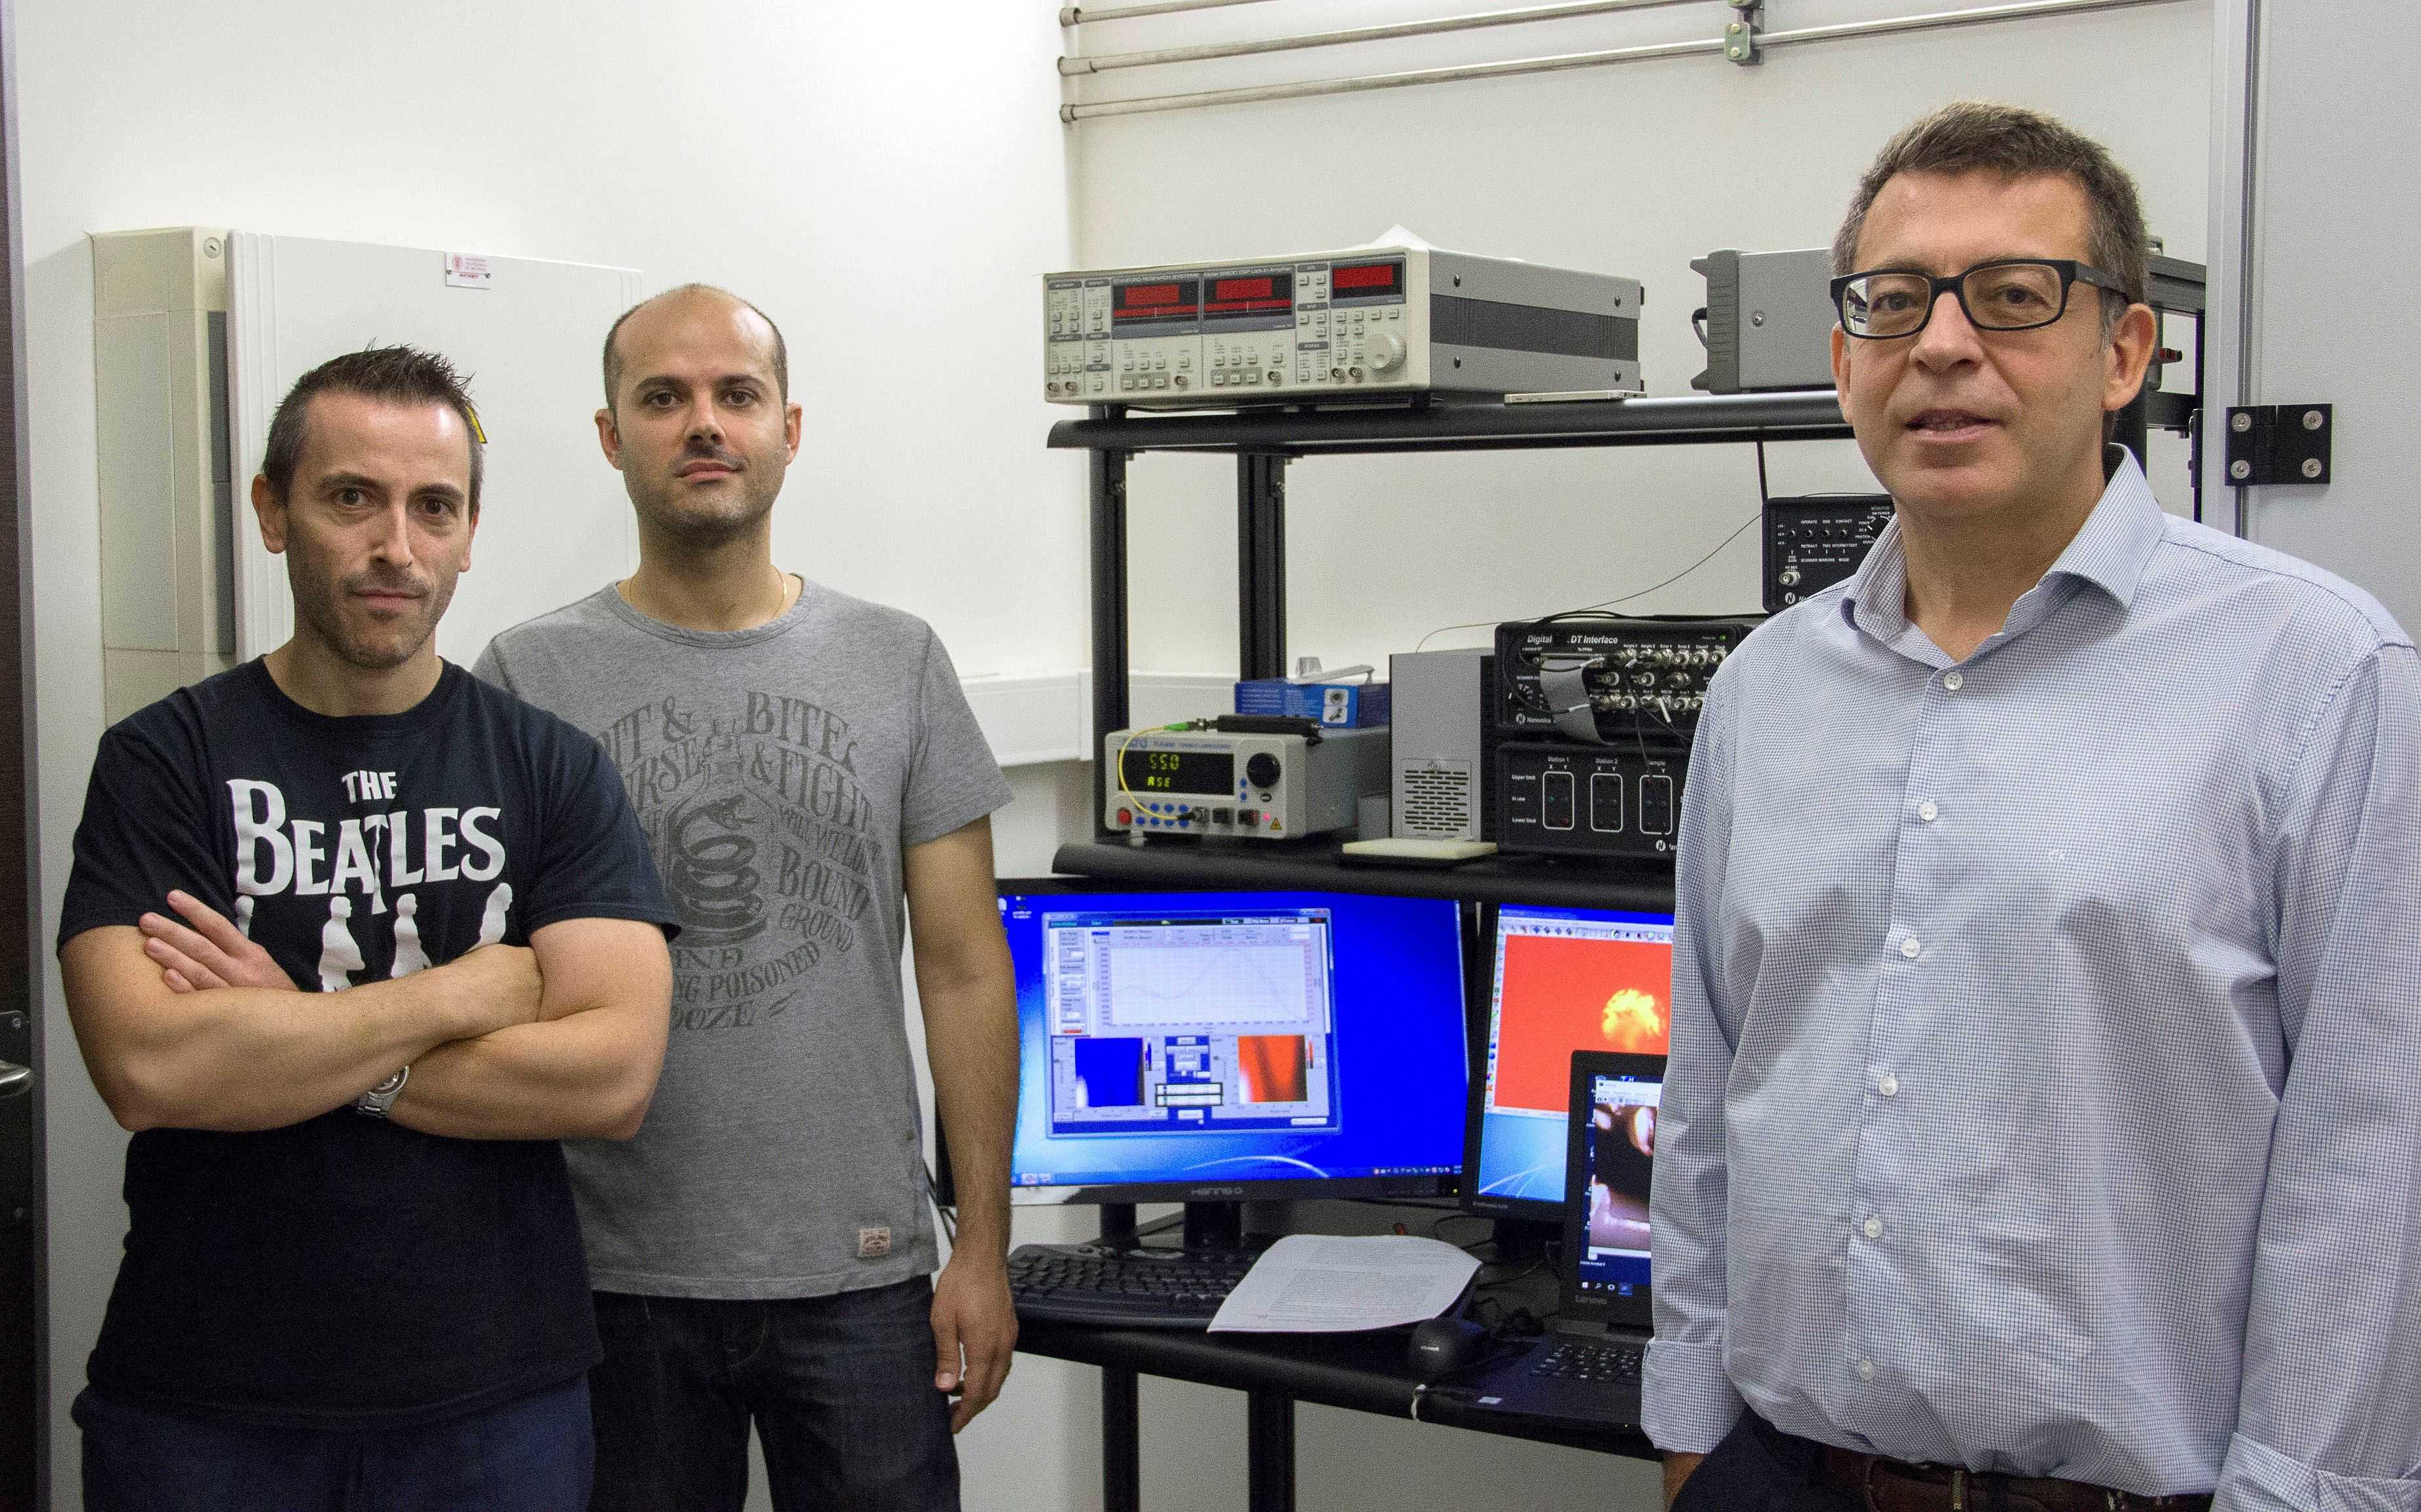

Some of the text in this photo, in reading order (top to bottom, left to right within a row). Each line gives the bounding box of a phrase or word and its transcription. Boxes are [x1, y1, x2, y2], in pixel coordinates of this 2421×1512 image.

[1527, 635, 1552, 644] Digital
[1583, 635, 1618, 644] Interface
[342, 770, 397, 803] THE
[226, 779, 505, 915] BEATLES
[777, 843, 870, 921] BOUND
[779, 904, 856, 953] GROUND
[708, 941, 821, 1002] POISONED
[1576, 1295, 1607, 1304] Lenovo
